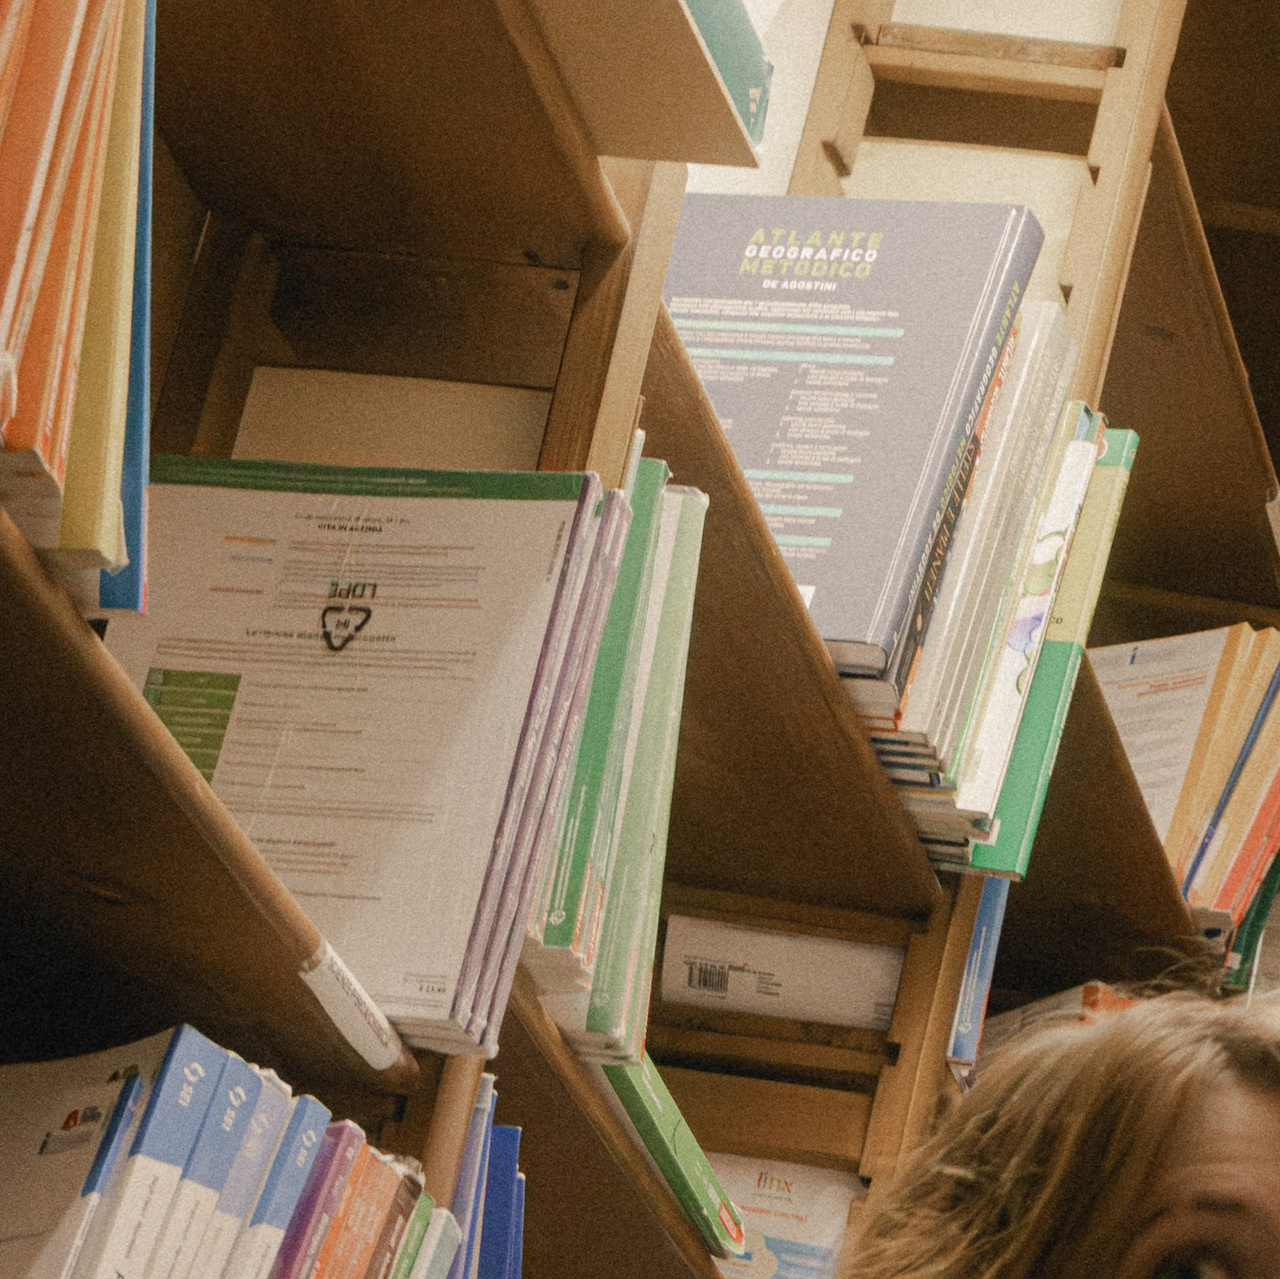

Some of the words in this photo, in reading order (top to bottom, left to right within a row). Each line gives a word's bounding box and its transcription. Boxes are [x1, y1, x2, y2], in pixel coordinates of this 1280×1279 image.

[749, 228, 884, 249] ATLANTE
[744, 245, 877, 263] GEOGRAFICO
[739, 259, 872, 279] METODICO
[762, 279, 778, 289] DE
[781, 280, 836, 291] AGOSTINI
[328, 580, 377, 598] LDPE
